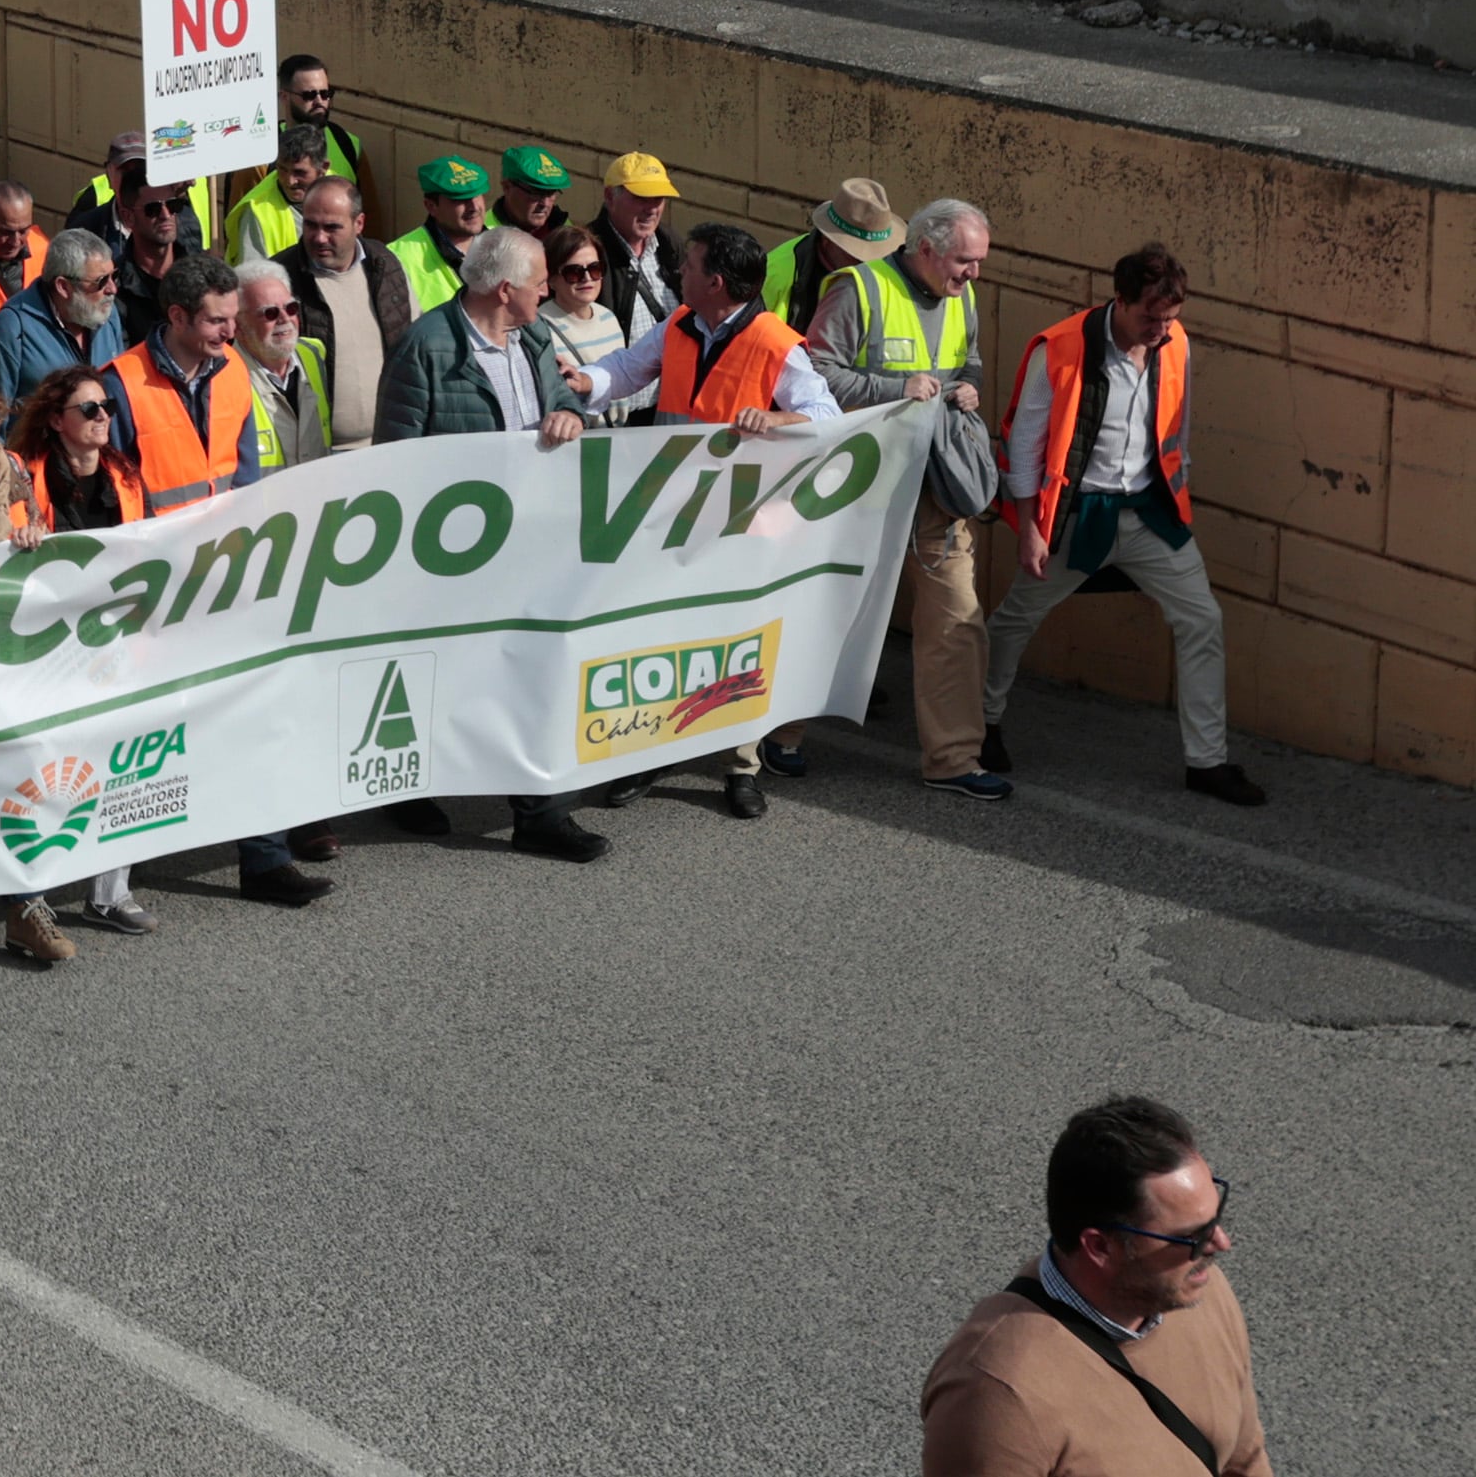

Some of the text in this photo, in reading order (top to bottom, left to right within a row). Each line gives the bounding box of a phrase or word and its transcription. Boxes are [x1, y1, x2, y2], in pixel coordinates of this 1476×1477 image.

[155, 52, 264, 98] AL CUADERNO DE CAMPO DIGITAL
[204, 116, 242, 134] COAG
[580, 427, 881, 564] Vivo
[588, 636, 761, 710] COAG
[586, 708, 666, 745] Cádiz
[109, 722, 186, 780] UPA
[347, 750, 420, 785] ASAJA
[99, 784, 188, 819] AGRICULTORES
[102, 774, 189, 805] Unión de Pequeños
[100, 798, 187, 833] y GANADEROS
